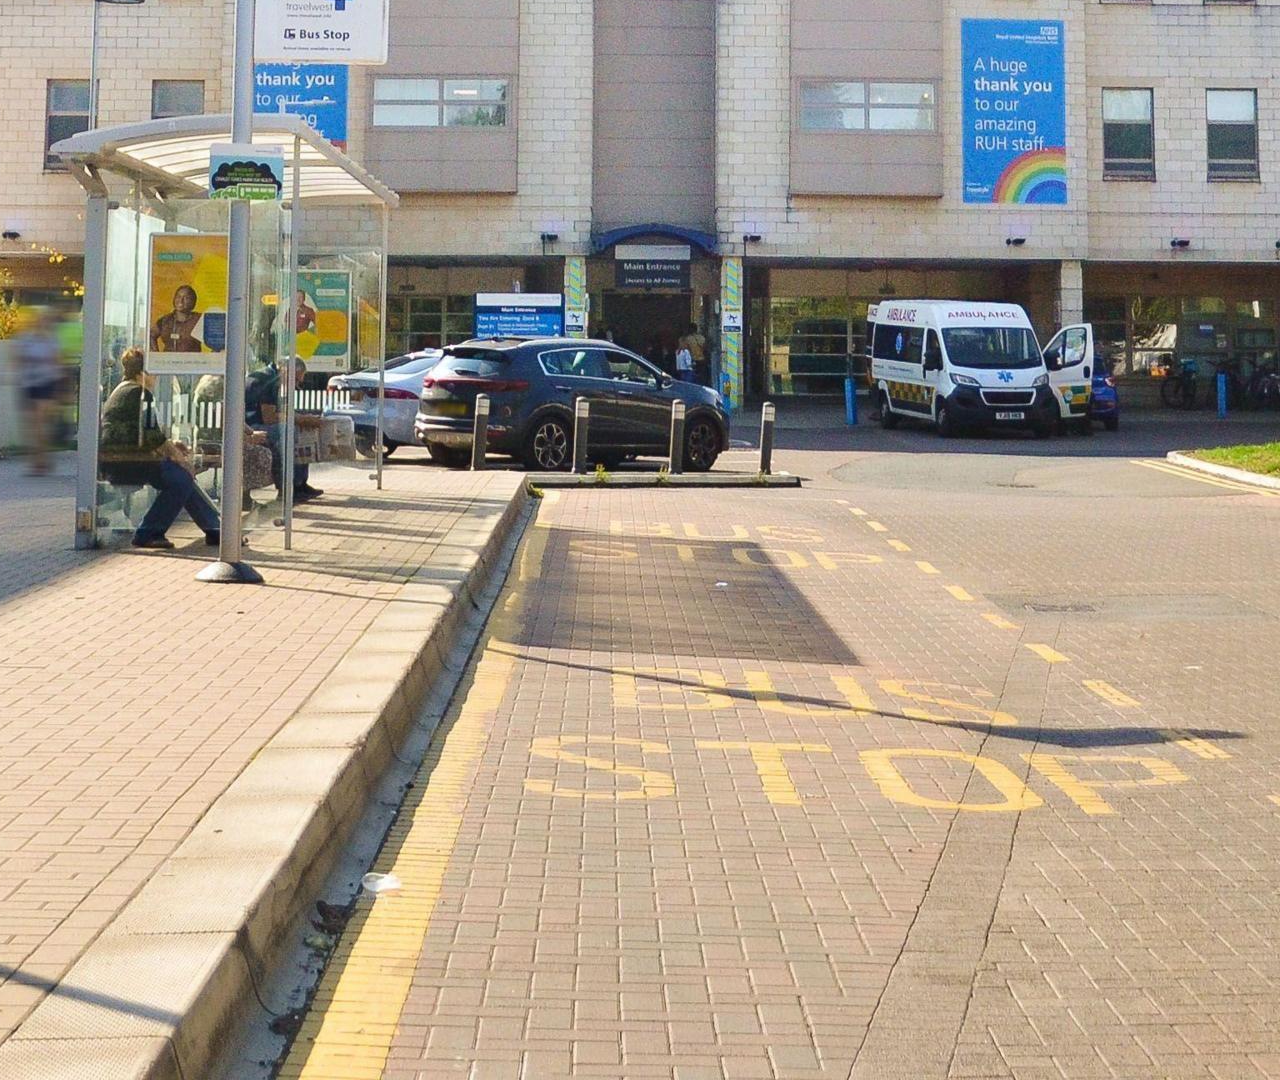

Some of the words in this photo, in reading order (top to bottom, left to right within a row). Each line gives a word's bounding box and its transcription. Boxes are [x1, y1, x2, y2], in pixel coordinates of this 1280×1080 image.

[286, 2, 333, 11] travelwest
[300, 29, 320, 39] Bus
[323, 29, 350, 42] Stop
[974, 58, 985, 71] A
[990, 57, 1027, 76] huge
[256, 72, 300, 86] thank
[306, 74, 335, 88] you
[974, 77, 1018, 92] thank
[1023, 81, 1052, 95] you
[256, 92, 271, 105] to
[275, 94, 300, 105] our
[975, 98, 990, 111] to
[994, 100, 1019, 111] our
[974, 117, 1036, 134] amazing
[975, 136, 1007, 150] RUH
[1012, 136, 1048, 150] staff.
[887, 308, 918, 322] AMBULANCE
[948, 311, 1019, 319] AMBULANCE
[610, 520, 824, 542] BUS
[569, 539, 884, 569] STOP
[612, 667, 1018, 726] BUS
[525, 735, 1191, 815] STOP
